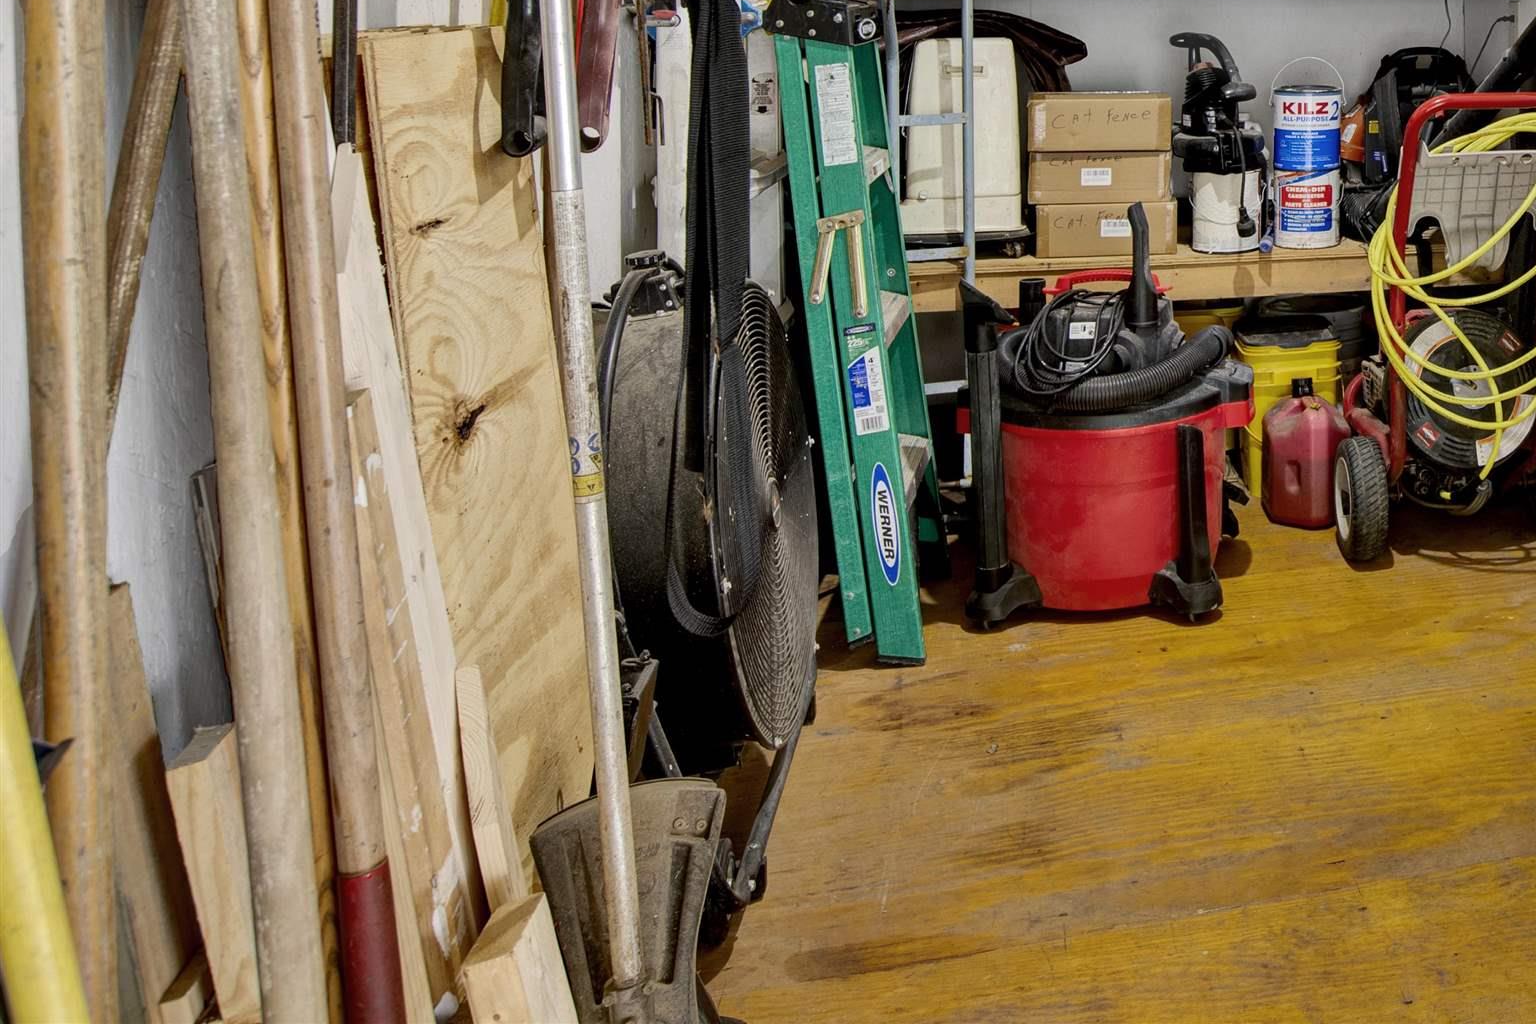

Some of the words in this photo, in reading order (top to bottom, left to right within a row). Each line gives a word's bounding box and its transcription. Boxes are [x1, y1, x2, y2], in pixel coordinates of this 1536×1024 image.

[1283, 101, 1329, 115] KILZ
[1329, 100, 1340, 121] 2
[877, 489, 895, 560] WERNER
